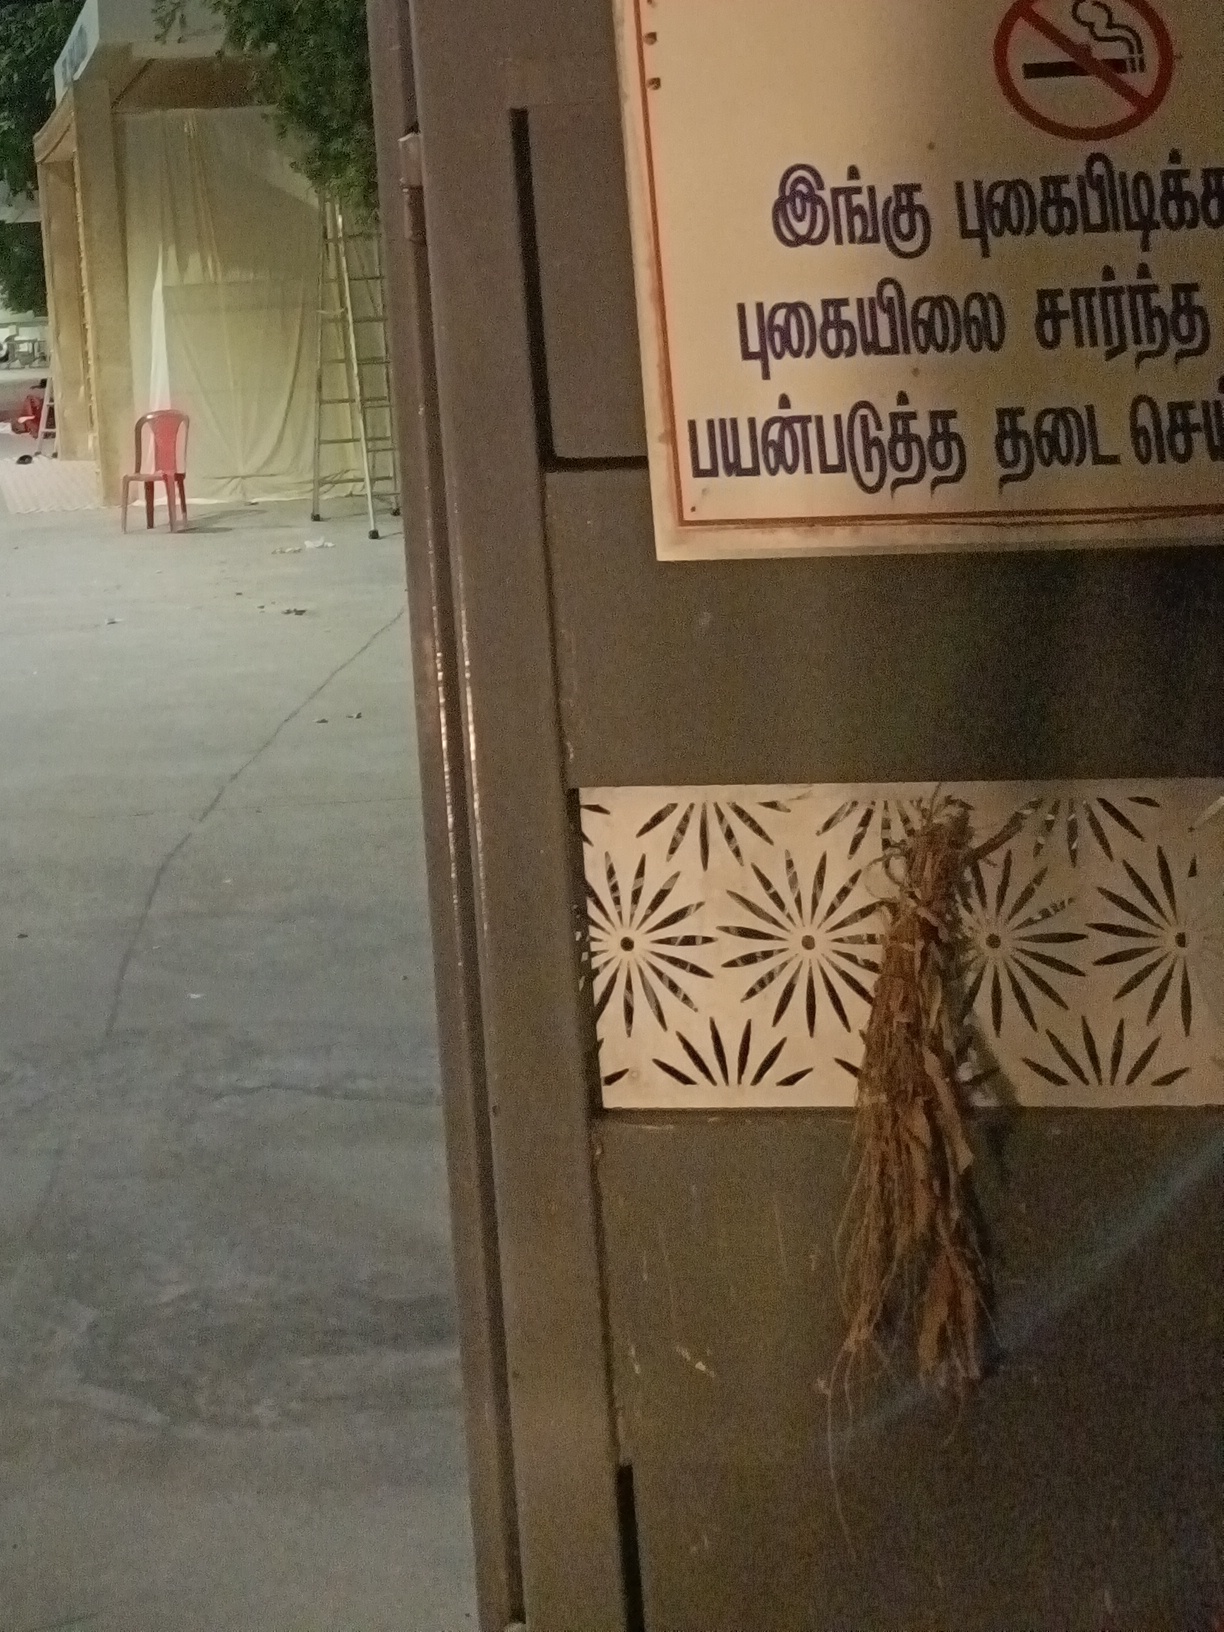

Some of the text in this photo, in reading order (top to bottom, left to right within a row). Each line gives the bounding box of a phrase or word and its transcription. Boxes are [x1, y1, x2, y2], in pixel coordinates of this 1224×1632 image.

[771, 163, 932, 260] இங்கு
[736, 261, 1212, 381] புகையிலை சார்ந்த
[687, 390, 968, 498] பயன்படுத்த
[993, 403, 1122, 495] தடை
